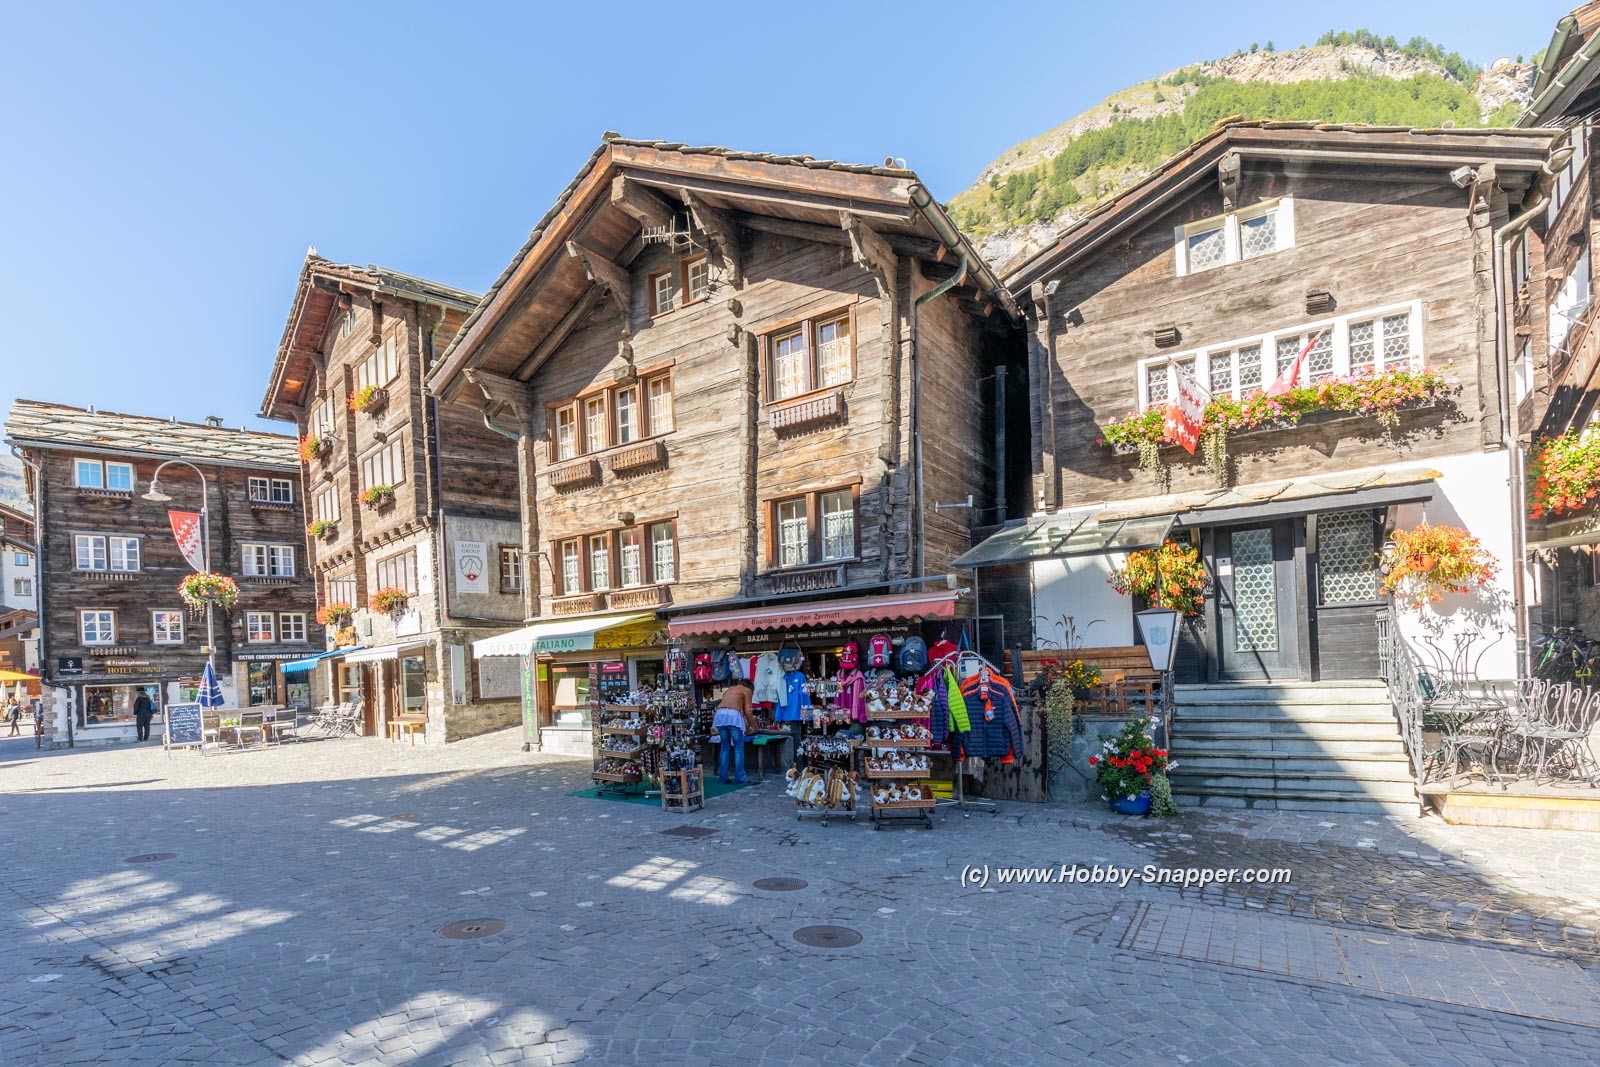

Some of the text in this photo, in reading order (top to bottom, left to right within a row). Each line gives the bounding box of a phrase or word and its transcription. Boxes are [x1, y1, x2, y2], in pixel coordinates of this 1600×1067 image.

[751, 616, 777, 625] Boutique
[813, 612, 840, 620] Zermatt
[747, 634, 769, 642] BAZAR
[489, 639, 575, 653] GELATO ITALIANO
[107, 666, 133, 675] HOTEL
[524, 670, 534, 738] GELATERIA
